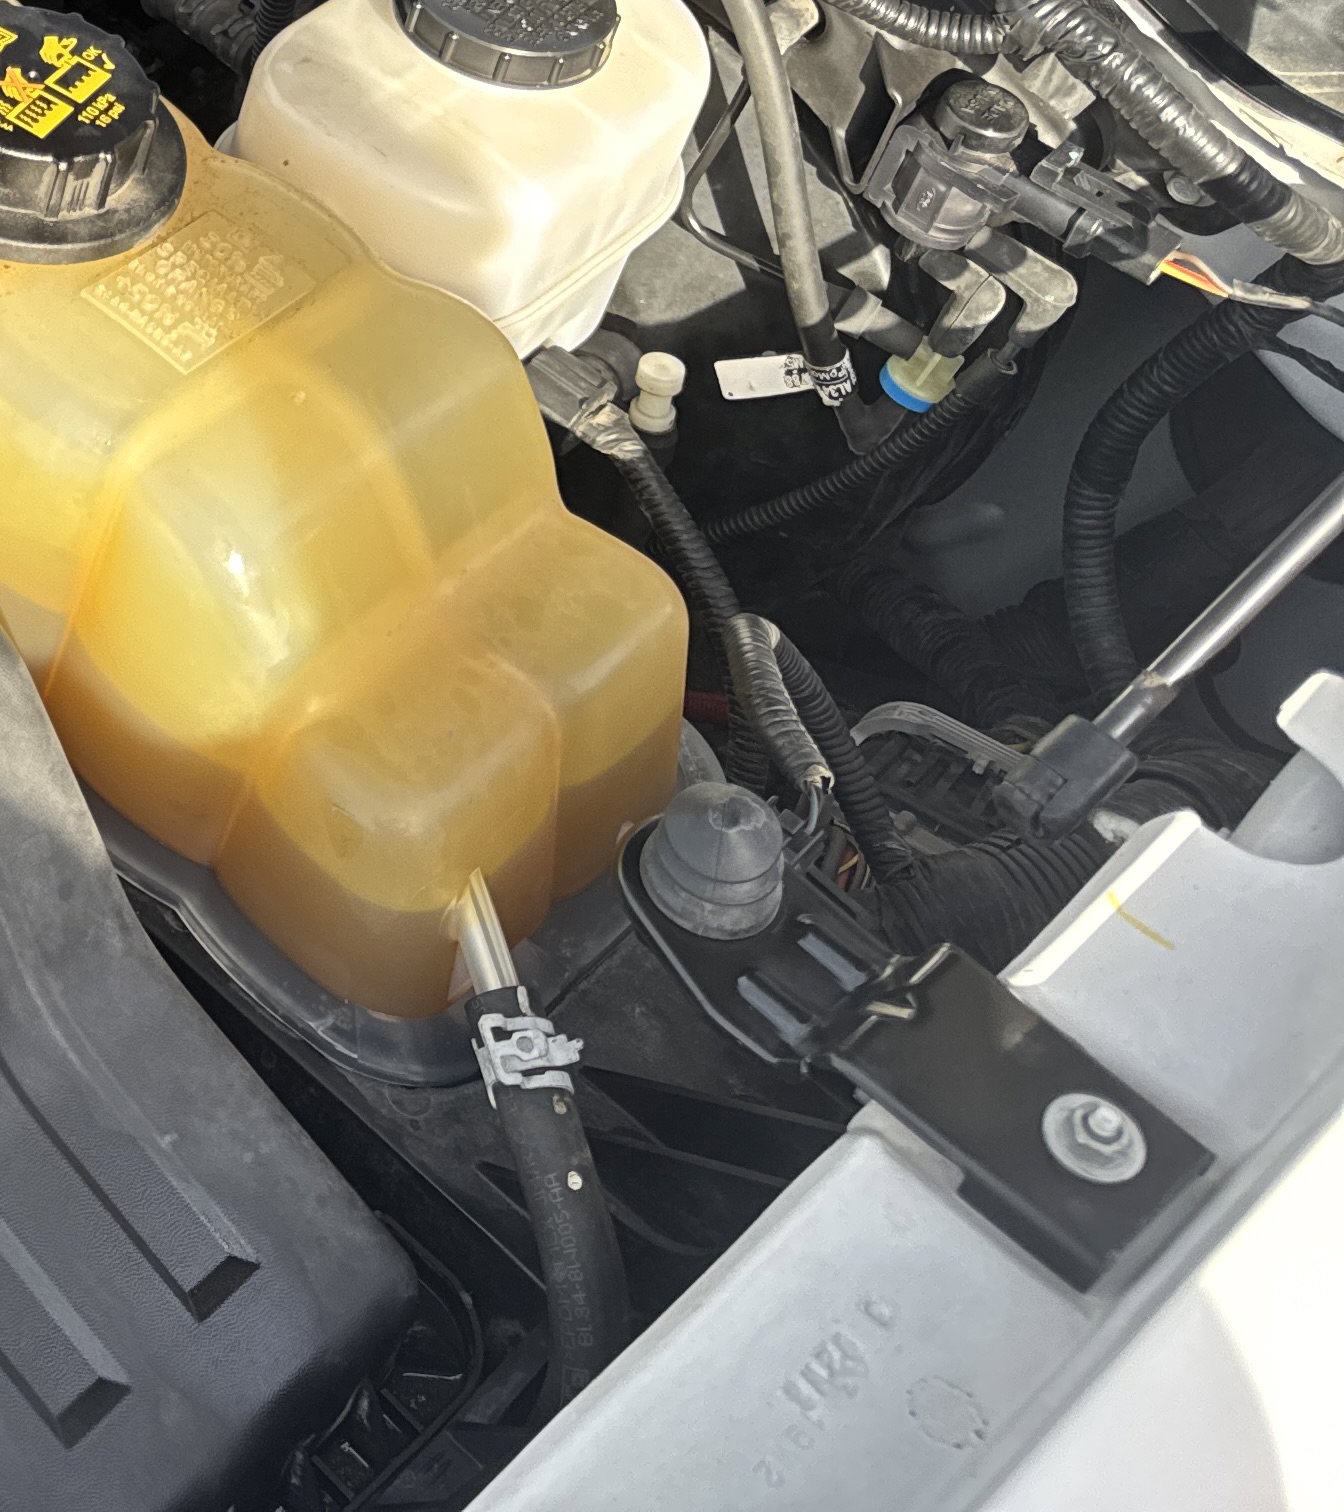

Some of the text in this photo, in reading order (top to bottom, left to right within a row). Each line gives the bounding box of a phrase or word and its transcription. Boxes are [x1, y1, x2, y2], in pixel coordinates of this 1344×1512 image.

[81, 45, 103, 62] OK
[77, 103, 100, 124] 110
[95, 113, 112, 128] 16
